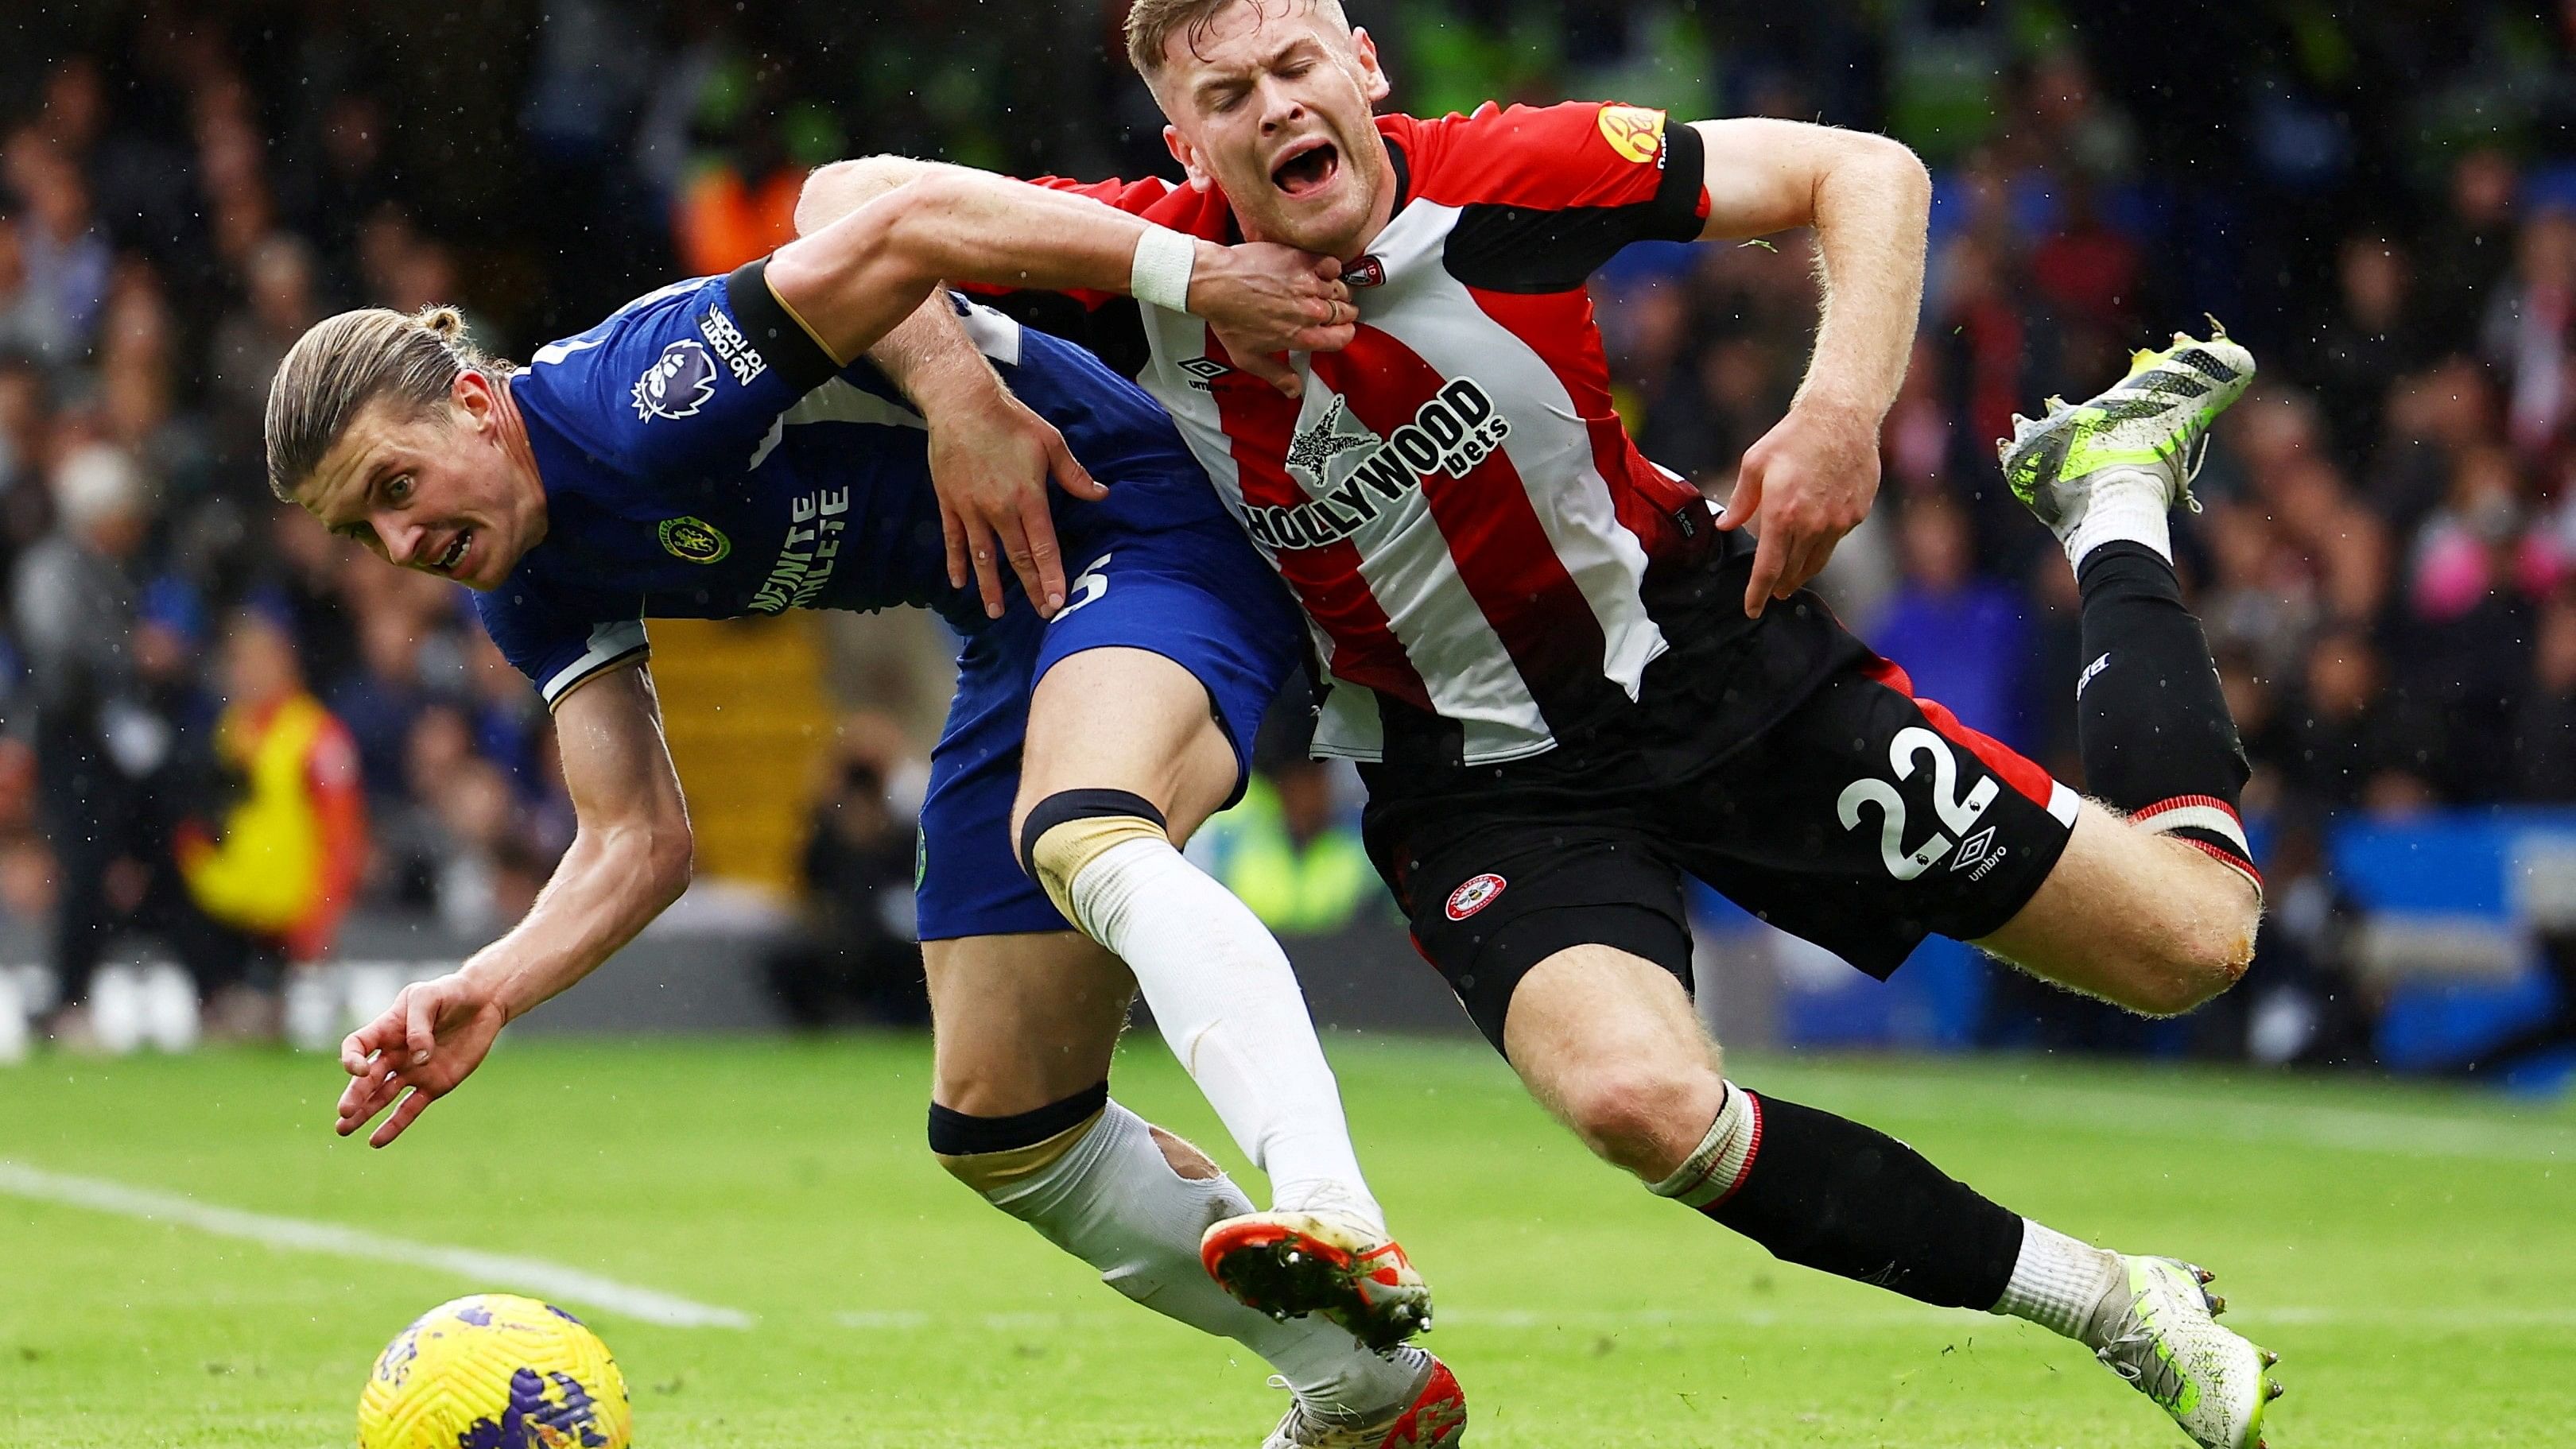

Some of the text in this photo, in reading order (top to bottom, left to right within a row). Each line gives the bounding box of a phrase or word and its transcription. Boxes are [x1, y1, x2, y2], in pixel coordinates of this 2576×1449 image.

[700, 320, 755, 386] No room
[709, 302, 749, 351] racism
[1240, 379, 1492, 547] HOLLYWOOD
[1441, 416, 1509, 476] bets
[1837, 726, 2000, 880] 22
[1969, 845, 2008, 881] umbro
